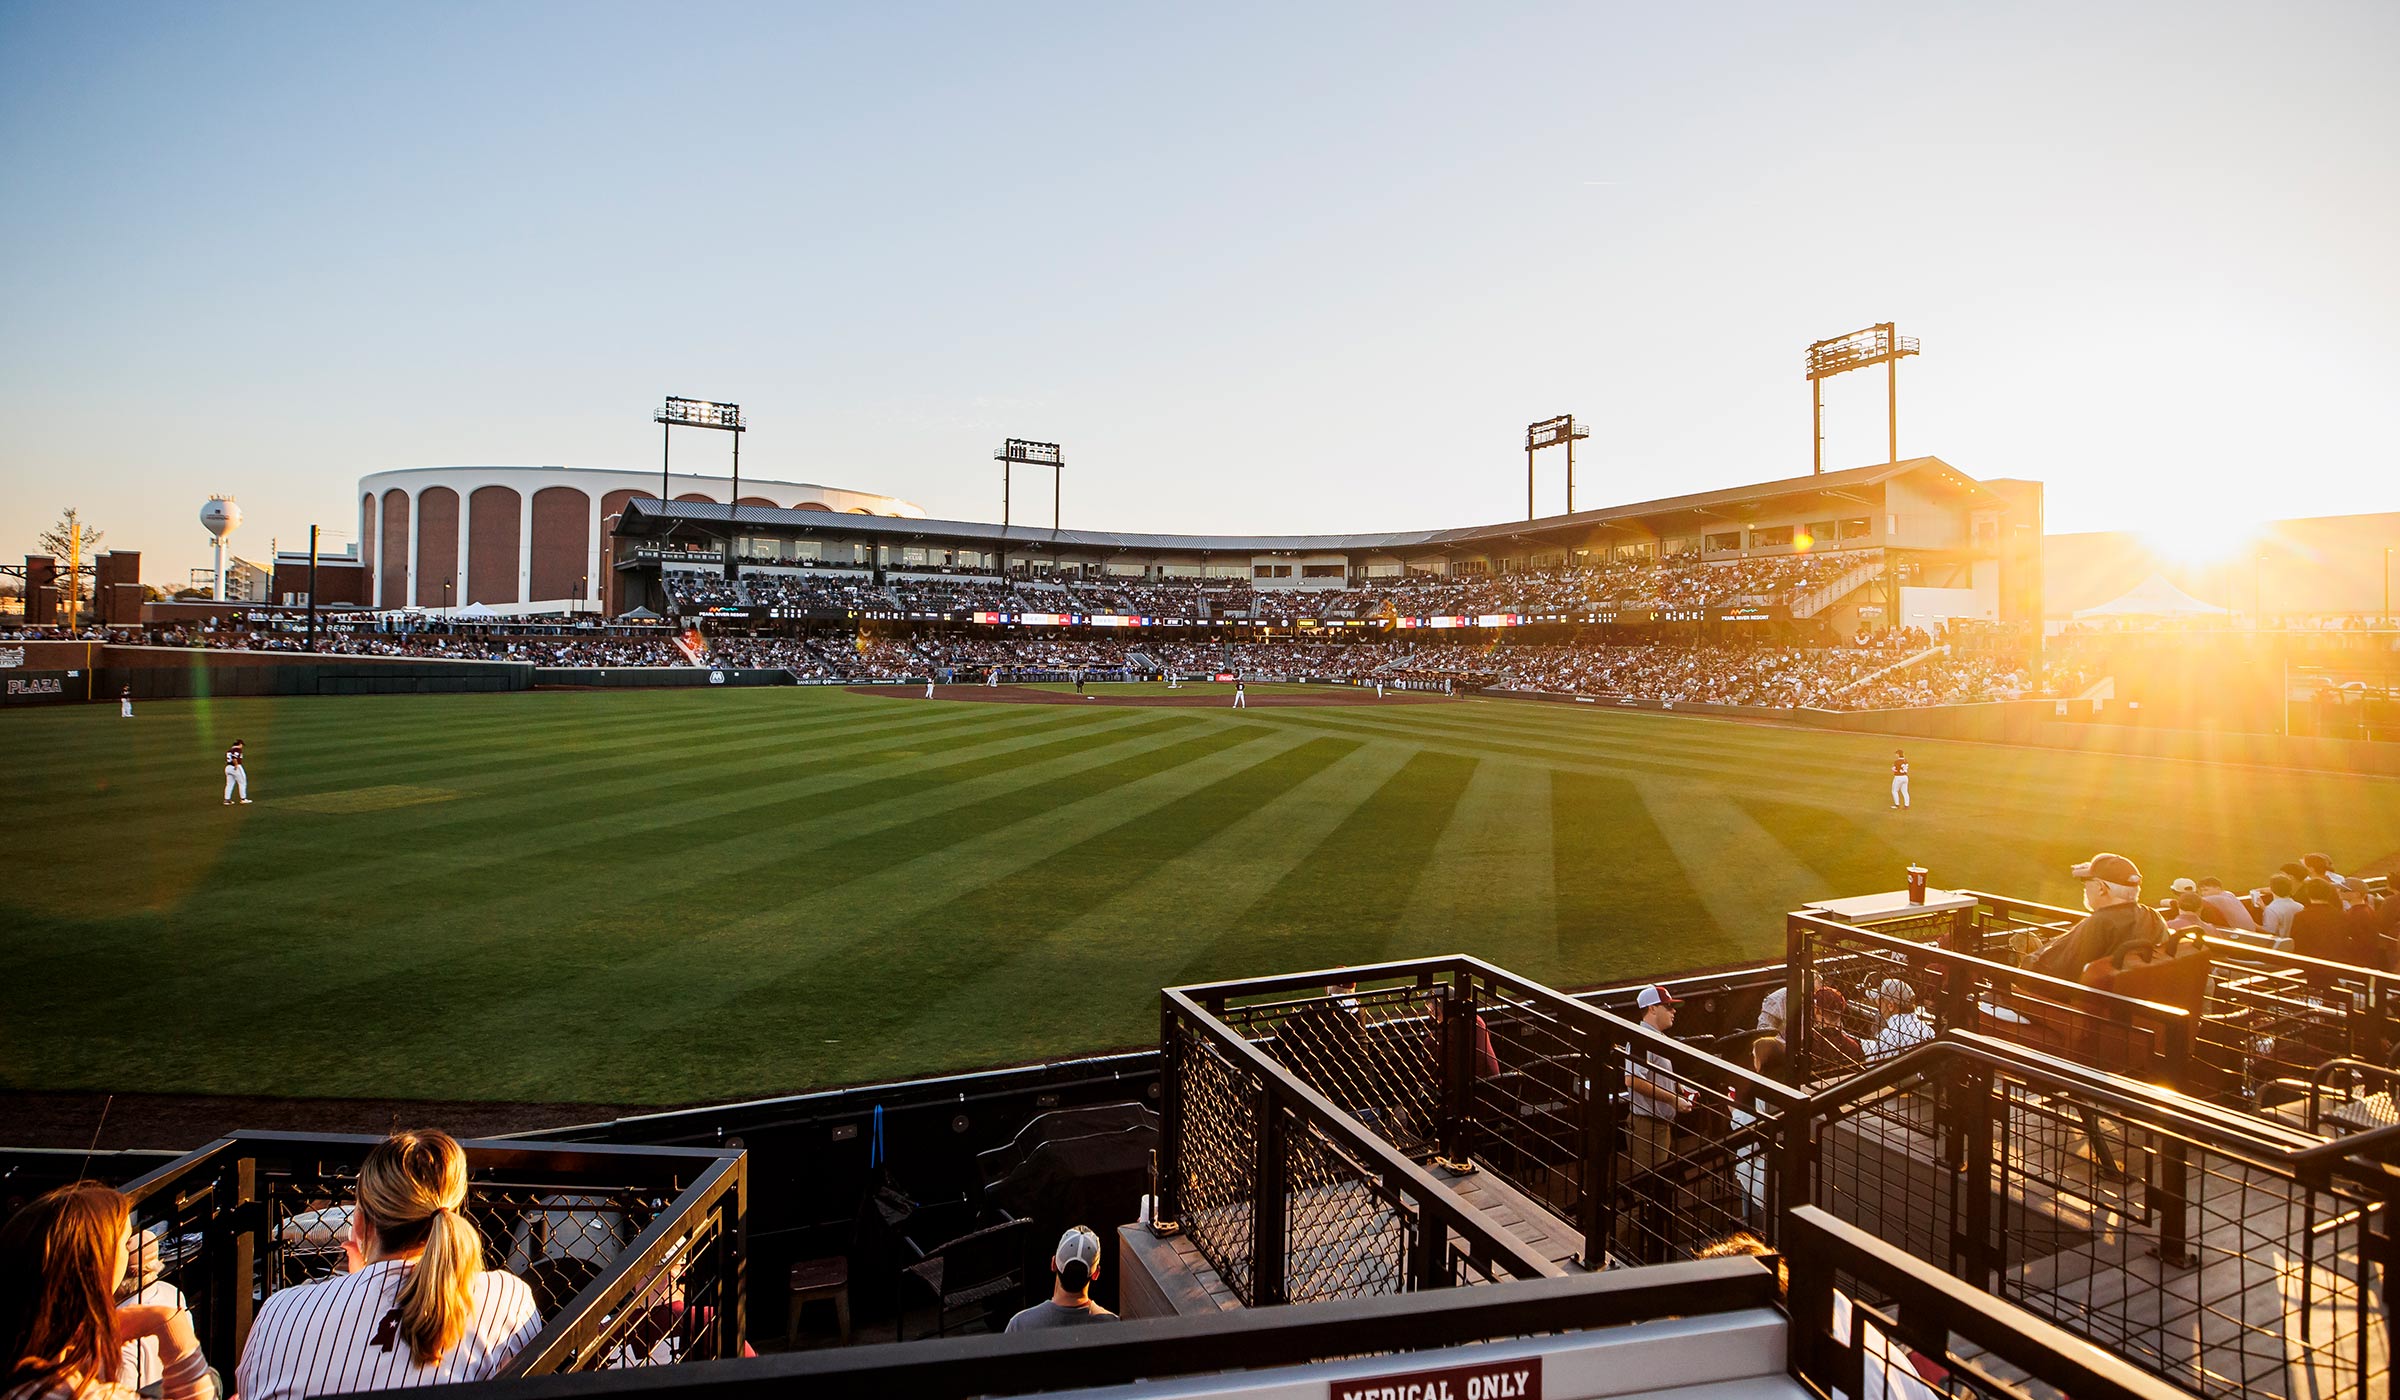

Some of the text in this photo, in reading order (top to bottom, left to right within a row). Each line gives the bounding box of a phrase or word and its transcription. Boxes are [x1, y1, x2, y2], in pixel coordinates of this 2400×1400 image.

[326, 624, 355, 632] BERM
[7, 679, 62, 694] PLAZA
[1467, 1370, 1530, 1400] ONLY
